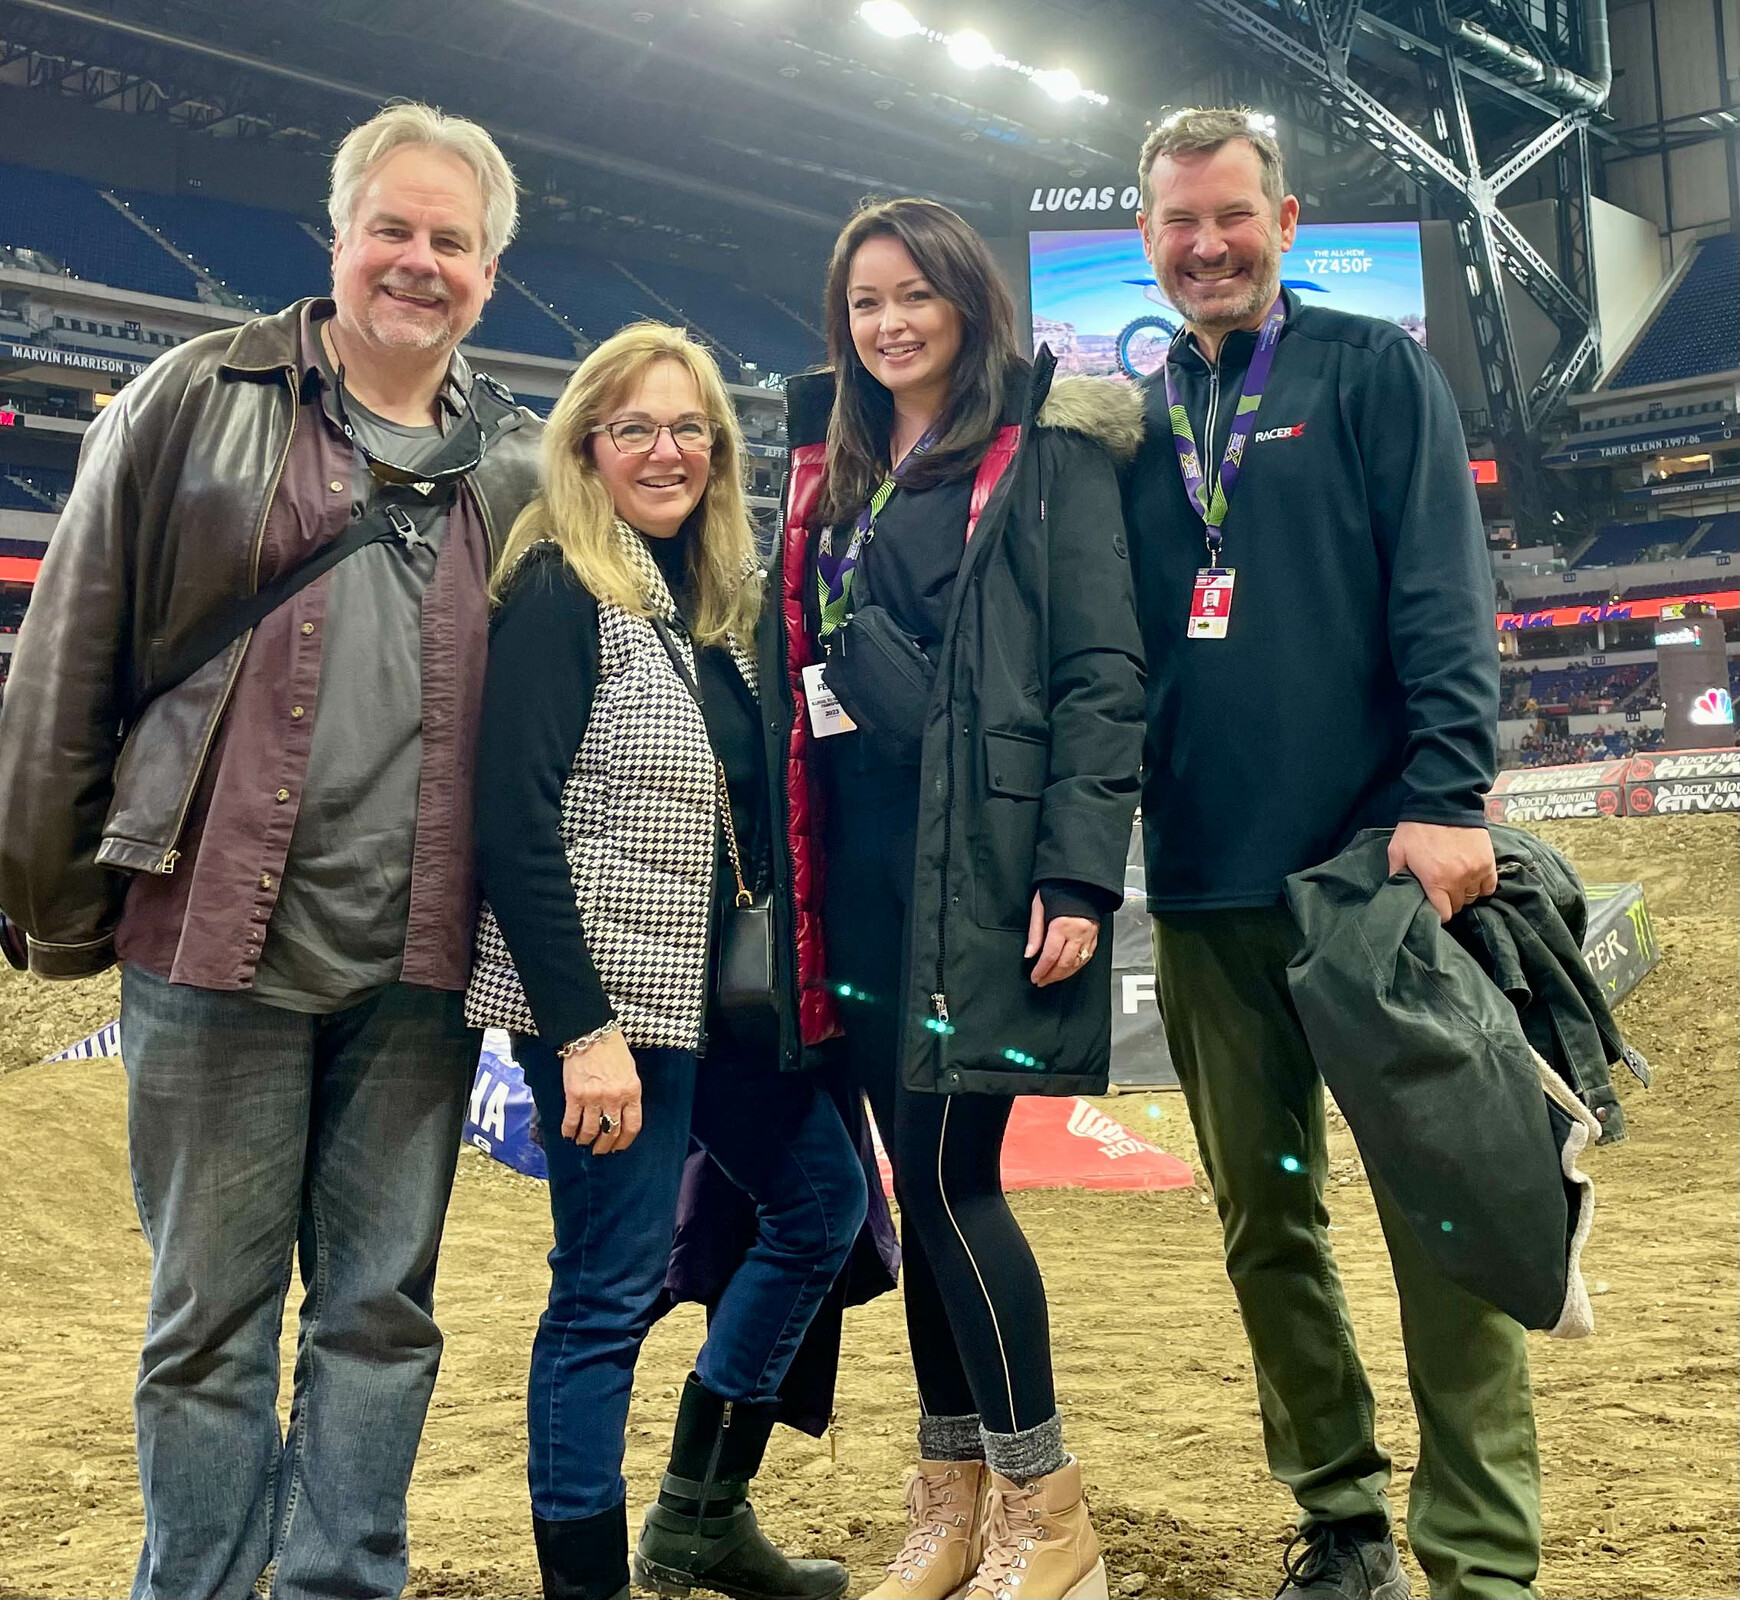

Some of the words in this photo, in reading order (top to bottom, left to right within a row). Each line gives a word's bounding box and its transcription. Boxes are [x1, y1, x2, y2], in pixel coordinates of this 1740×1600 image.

[1029, 186, 1116, 212] LUCAS
[1119, 186, 1143, 209] O
[1331, 249, 1365, 257] ALL-NEW
[1305, 258, 1373, 274] YZ450F
[12, 346, 60, 363] MARVIN
[64, 354, 124, 373] HARRISON
[764, 447, 782, 457] JEFF
[1600, 445, 1628, 458] TARIK
[1630, 441, 1662, 453] GLENN
[1665, 435, 1700, 448] 1997-06
[1676, 755, 1717, 765] ROCKY
[1673, 784, 1712, 795] ROCKY
[1518, 796, 1546, 807] ROCKY
[1547, 791, 1597, 805] MOUNTAIN
